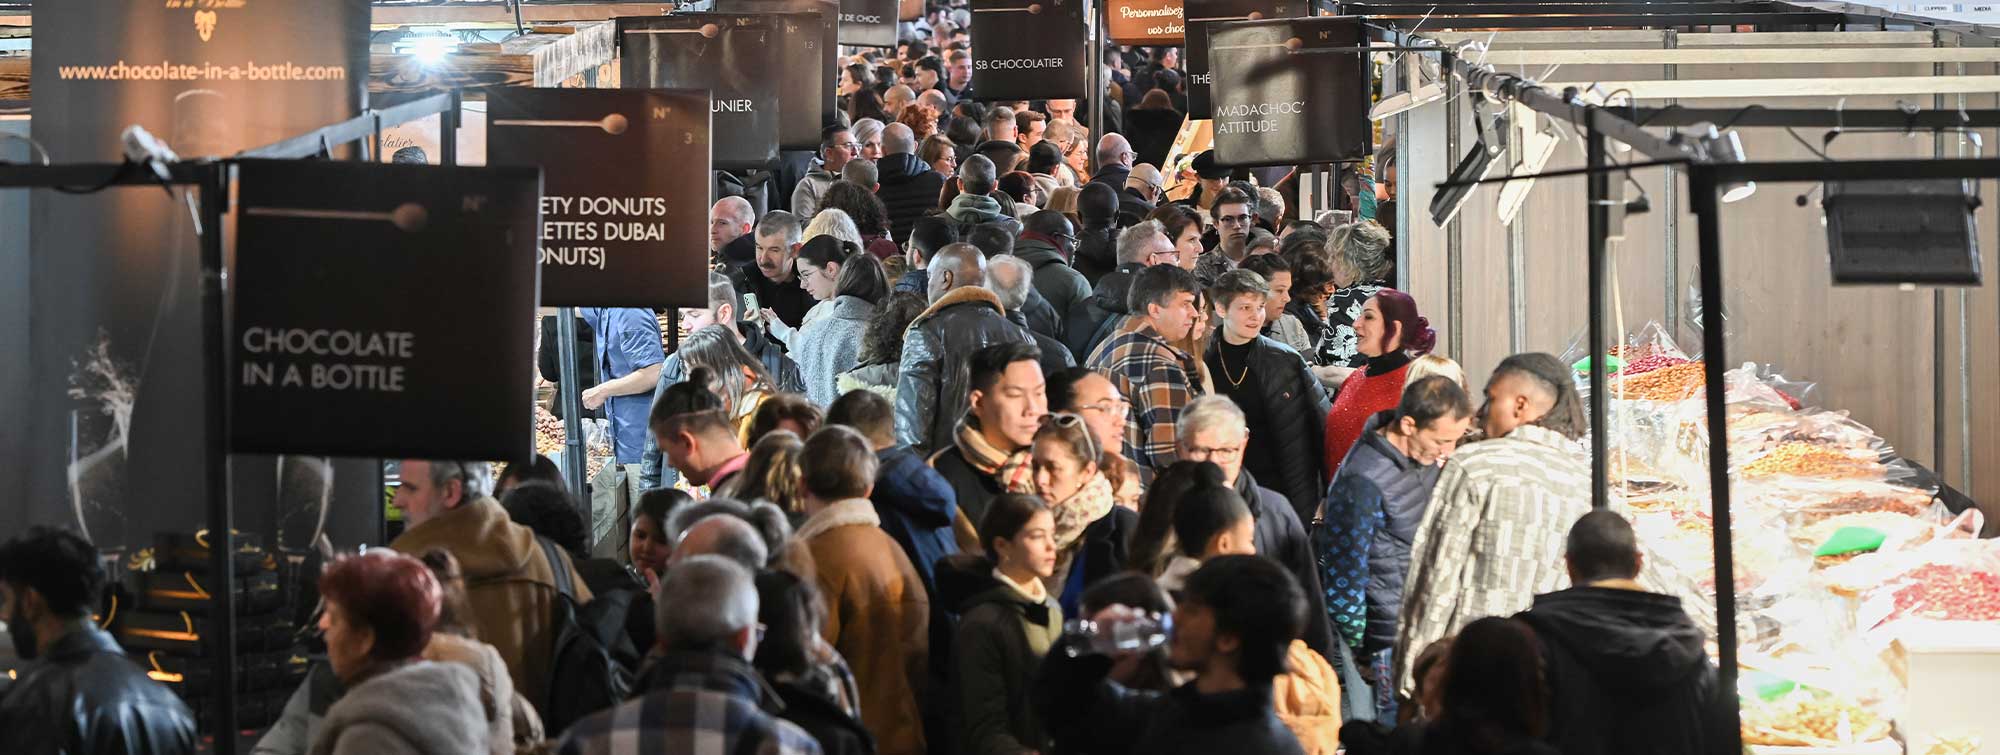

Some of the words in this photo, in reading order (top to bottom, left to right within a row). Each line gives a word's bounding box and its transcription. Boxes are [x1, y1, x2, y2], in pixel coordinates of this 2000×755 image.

[845, 14, 854, 22] DE
[856, 14, 881, 23] CHOC
[1120, 5, 1183, 19] Personnalisez
[1147, 26, 1163, 35] vos
[59, 60, 345, 80] www.chocolate-in-a-bottle.com
[975, 60, 989, 70] SB
[991, 58, 1064, 69] CHOCOLATIER
[710, 99, 753, 112] UNIER
[1218, 119, 1279, 135] ATTITUDE
[684, 132, 692, 144] 3
[580, 196, 667, 216] DONUTS
[604, 222, 665, 241] DUBAI
[242, 326, 414, 358] CHOCOLATE
[243, 361, 274, 387] IN
[281, 363, 303, 388] A
[311, 363, 405, 392] BOTTLE
